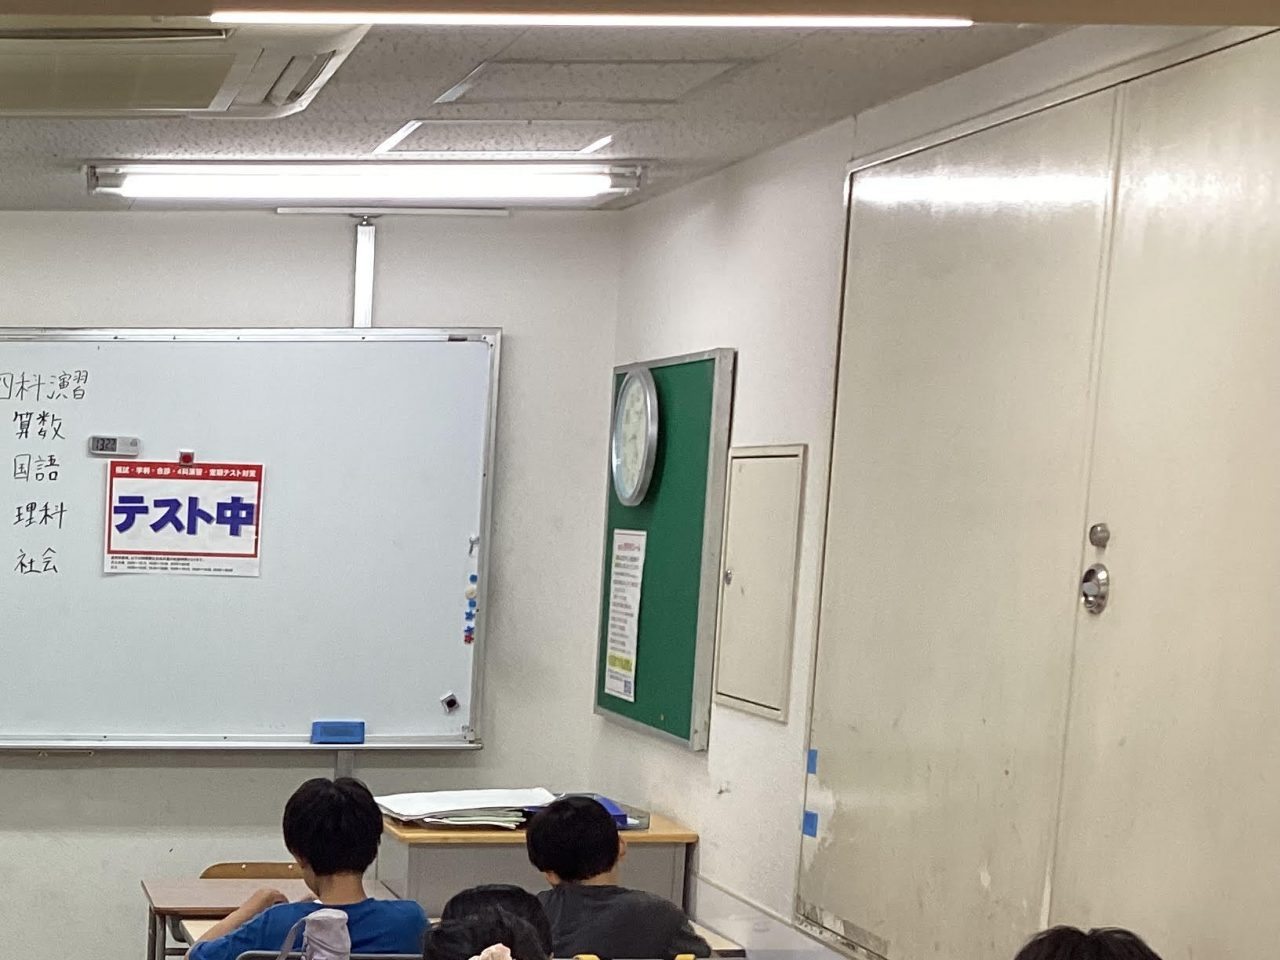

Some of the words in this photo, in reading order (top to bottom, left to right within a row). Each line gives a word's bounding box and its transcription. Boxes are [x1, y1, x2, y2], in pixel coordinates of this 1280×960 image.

[12, 410, 66, 441] 算数
[13, 453, 61, 482] 国語
[12, 501, 68, 530] 理科
[113, 495, 255, 537] テスト中
[13, 546, 59, 575] 社会
